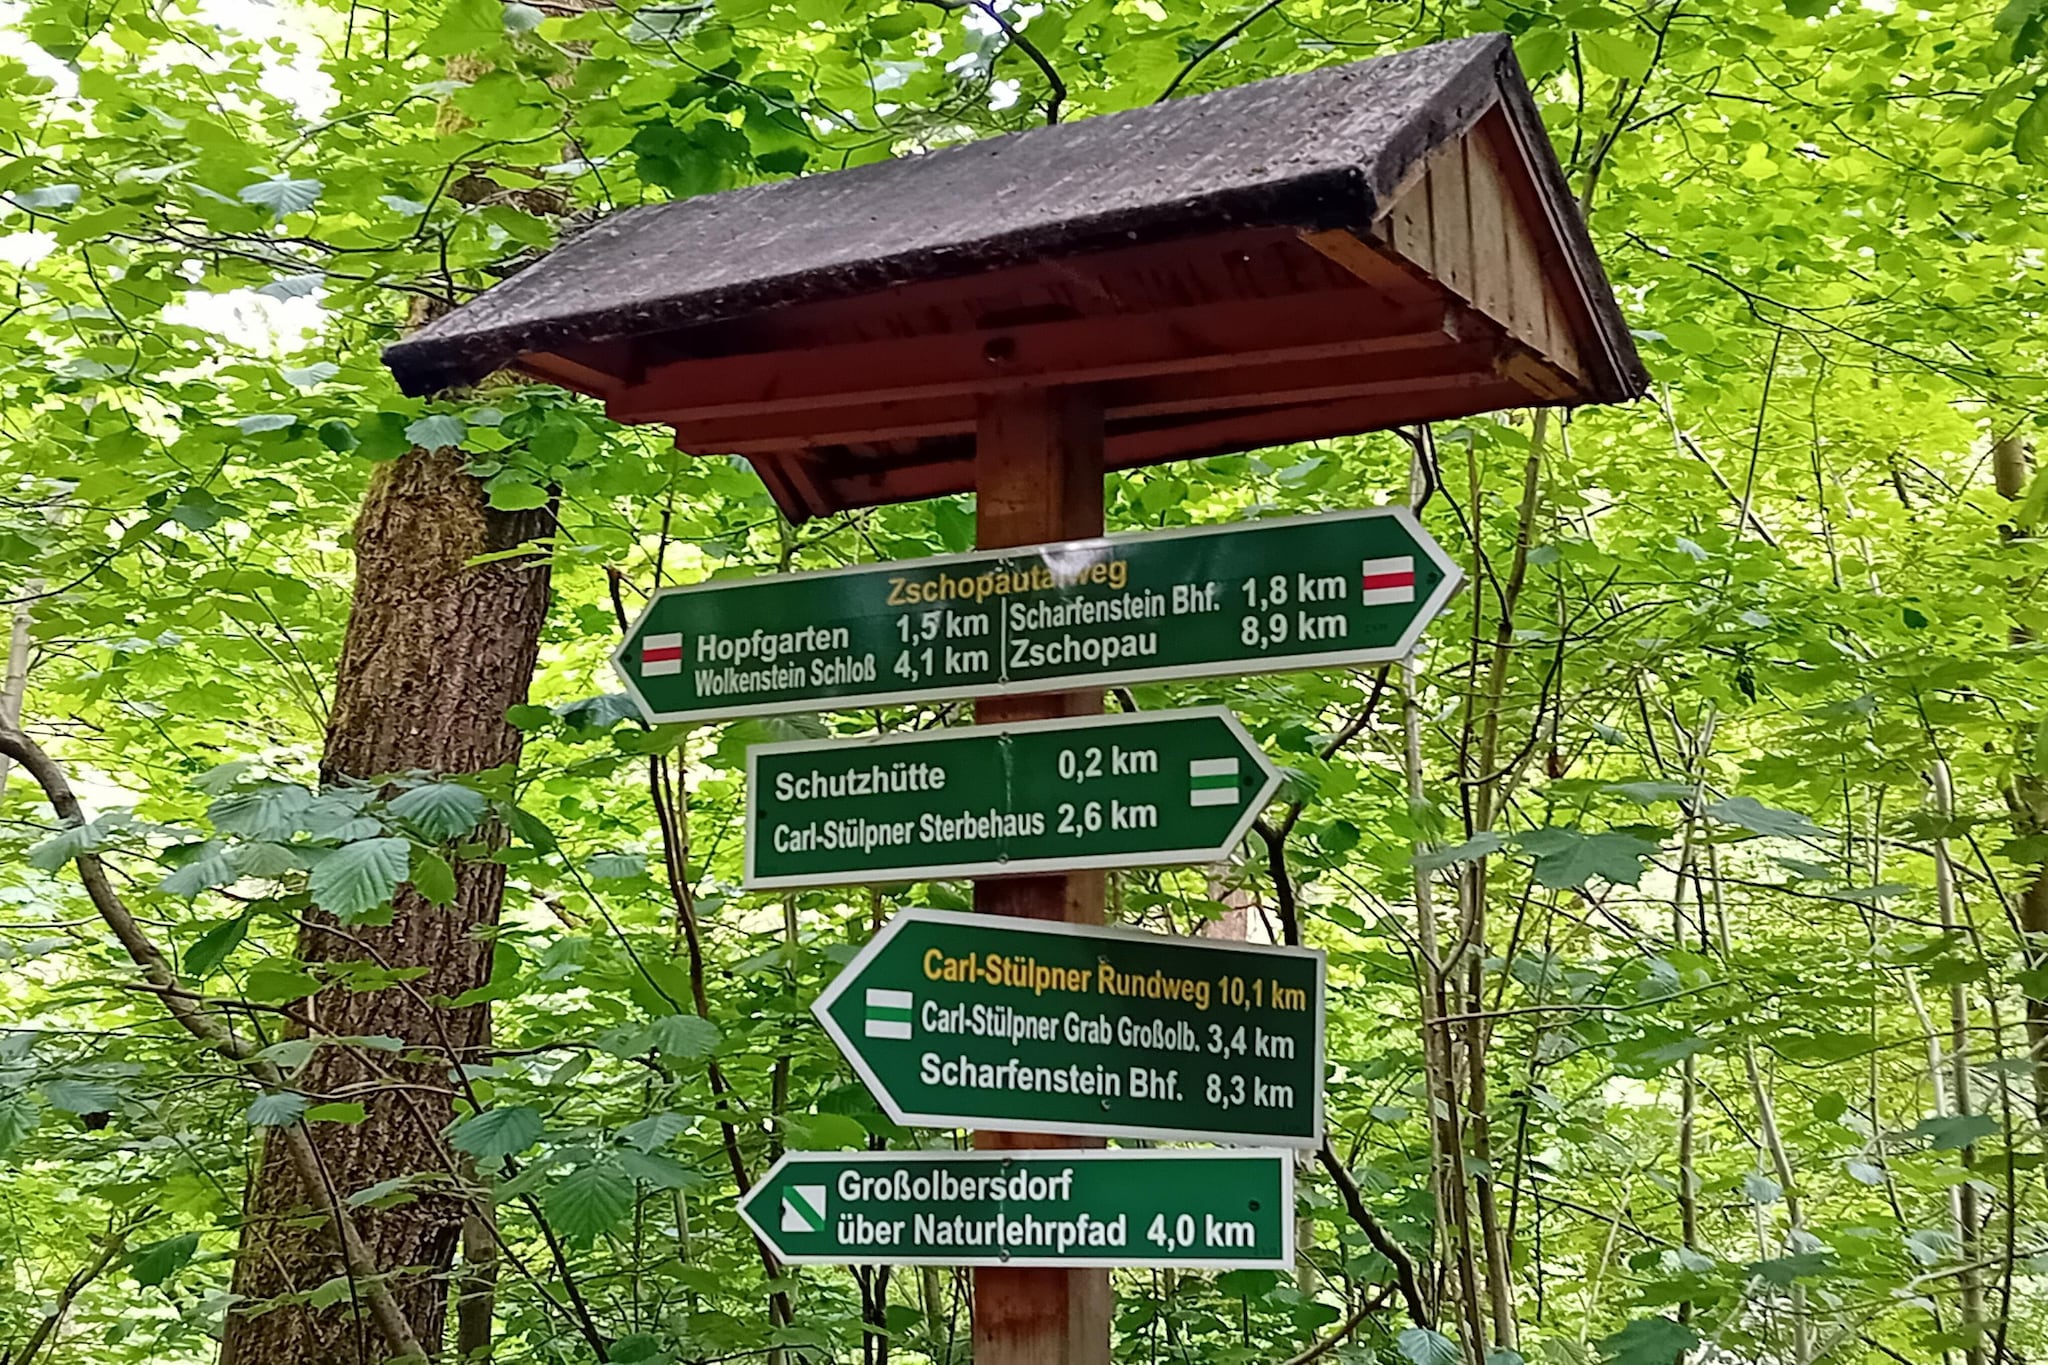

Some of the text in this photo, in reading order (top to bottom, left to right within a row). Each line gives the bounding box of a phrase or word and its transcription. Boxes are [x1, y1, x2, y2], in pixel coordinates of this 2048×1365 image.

[886, 558, 1128, 606] Zschopautaweg
[1009, 573, 1347, 632] Scharfenstein Bhf. 1,8 km
[696, 613, 990, 663] Hopfgarten 1,5 km
[1009, 612, 1348, 668] Zschopau 8,9 km
[695, 648, 990, 698] Wolkenstein Schloß 4,1 km
[775, 745, 1159, 801] Schutzhütte 0,2 km
[773, 801, 1158, 854] Carl-Stülpner Sterbehaus 2,6 km
[922, 947, 1307, 1011] Carl-Stülpner Rundweg 10,1 km
[921, 1000, 1295, 1060] Carl-Stülpner Grab Großolb. 3,4 km
[920, 1052, 1294, 1109] Scharfenstein Bhf. 8,3 km
[837, 1168, 1073, 1202] Großolbersdorf
[837, 1213, 1256, 1253] über Naturlehrpfad 4,0 km
